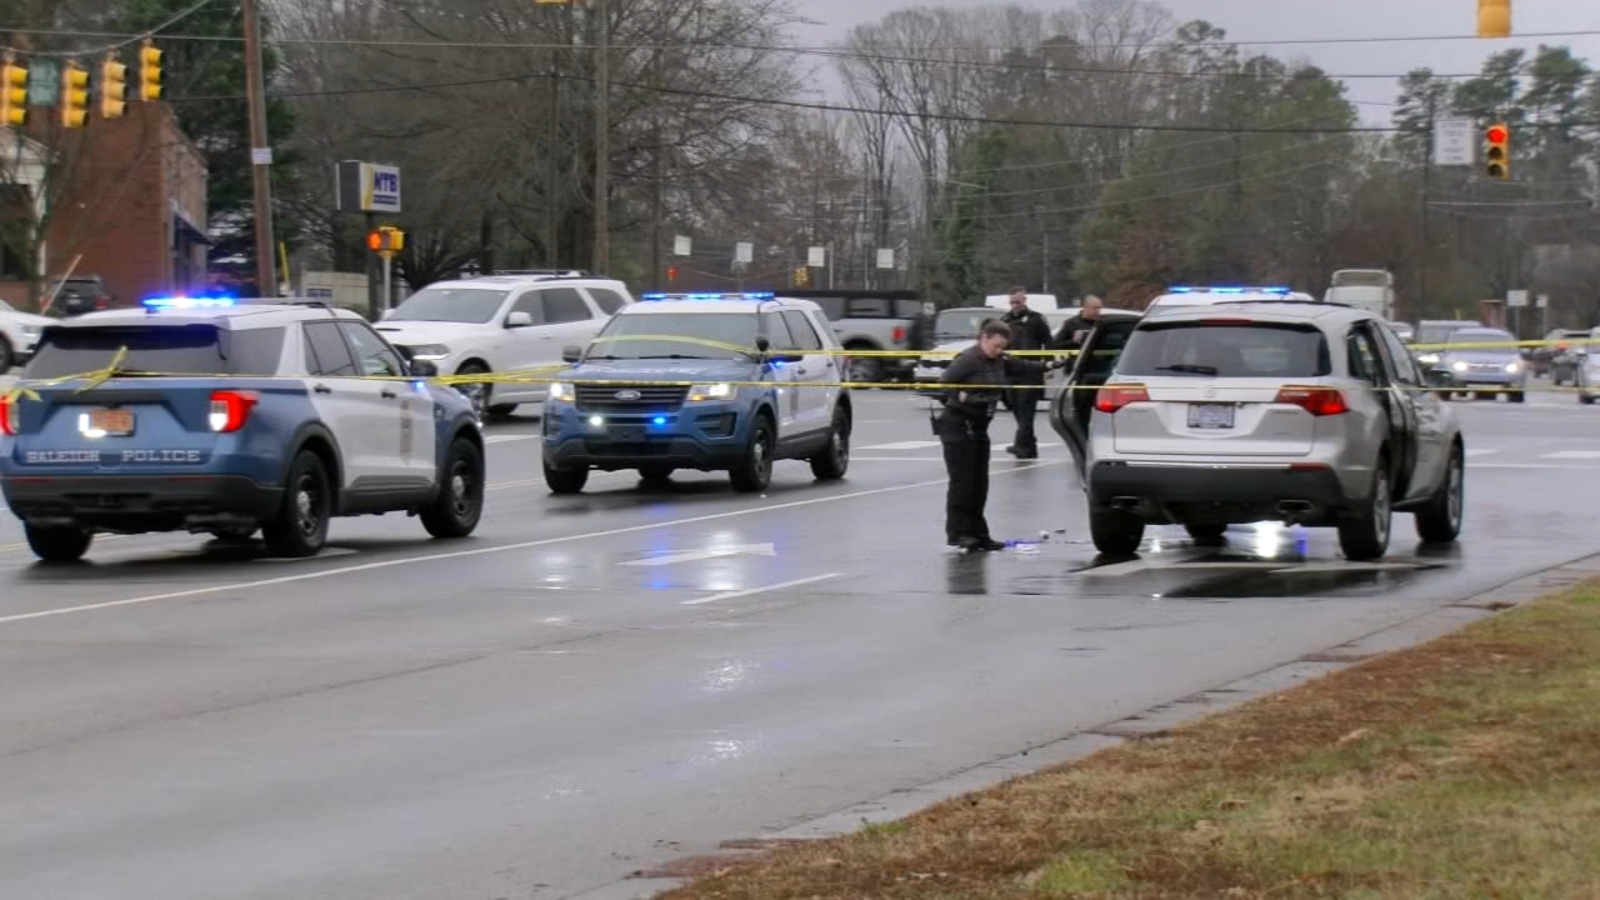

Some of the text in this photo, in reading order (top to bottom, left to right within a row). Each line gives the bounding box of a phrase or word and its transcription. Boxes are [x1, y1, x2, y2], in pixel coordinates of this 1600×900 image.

[374, 171, 397, 192] NTB
[26, 449, 201, 463] RALEIGH POLICE
